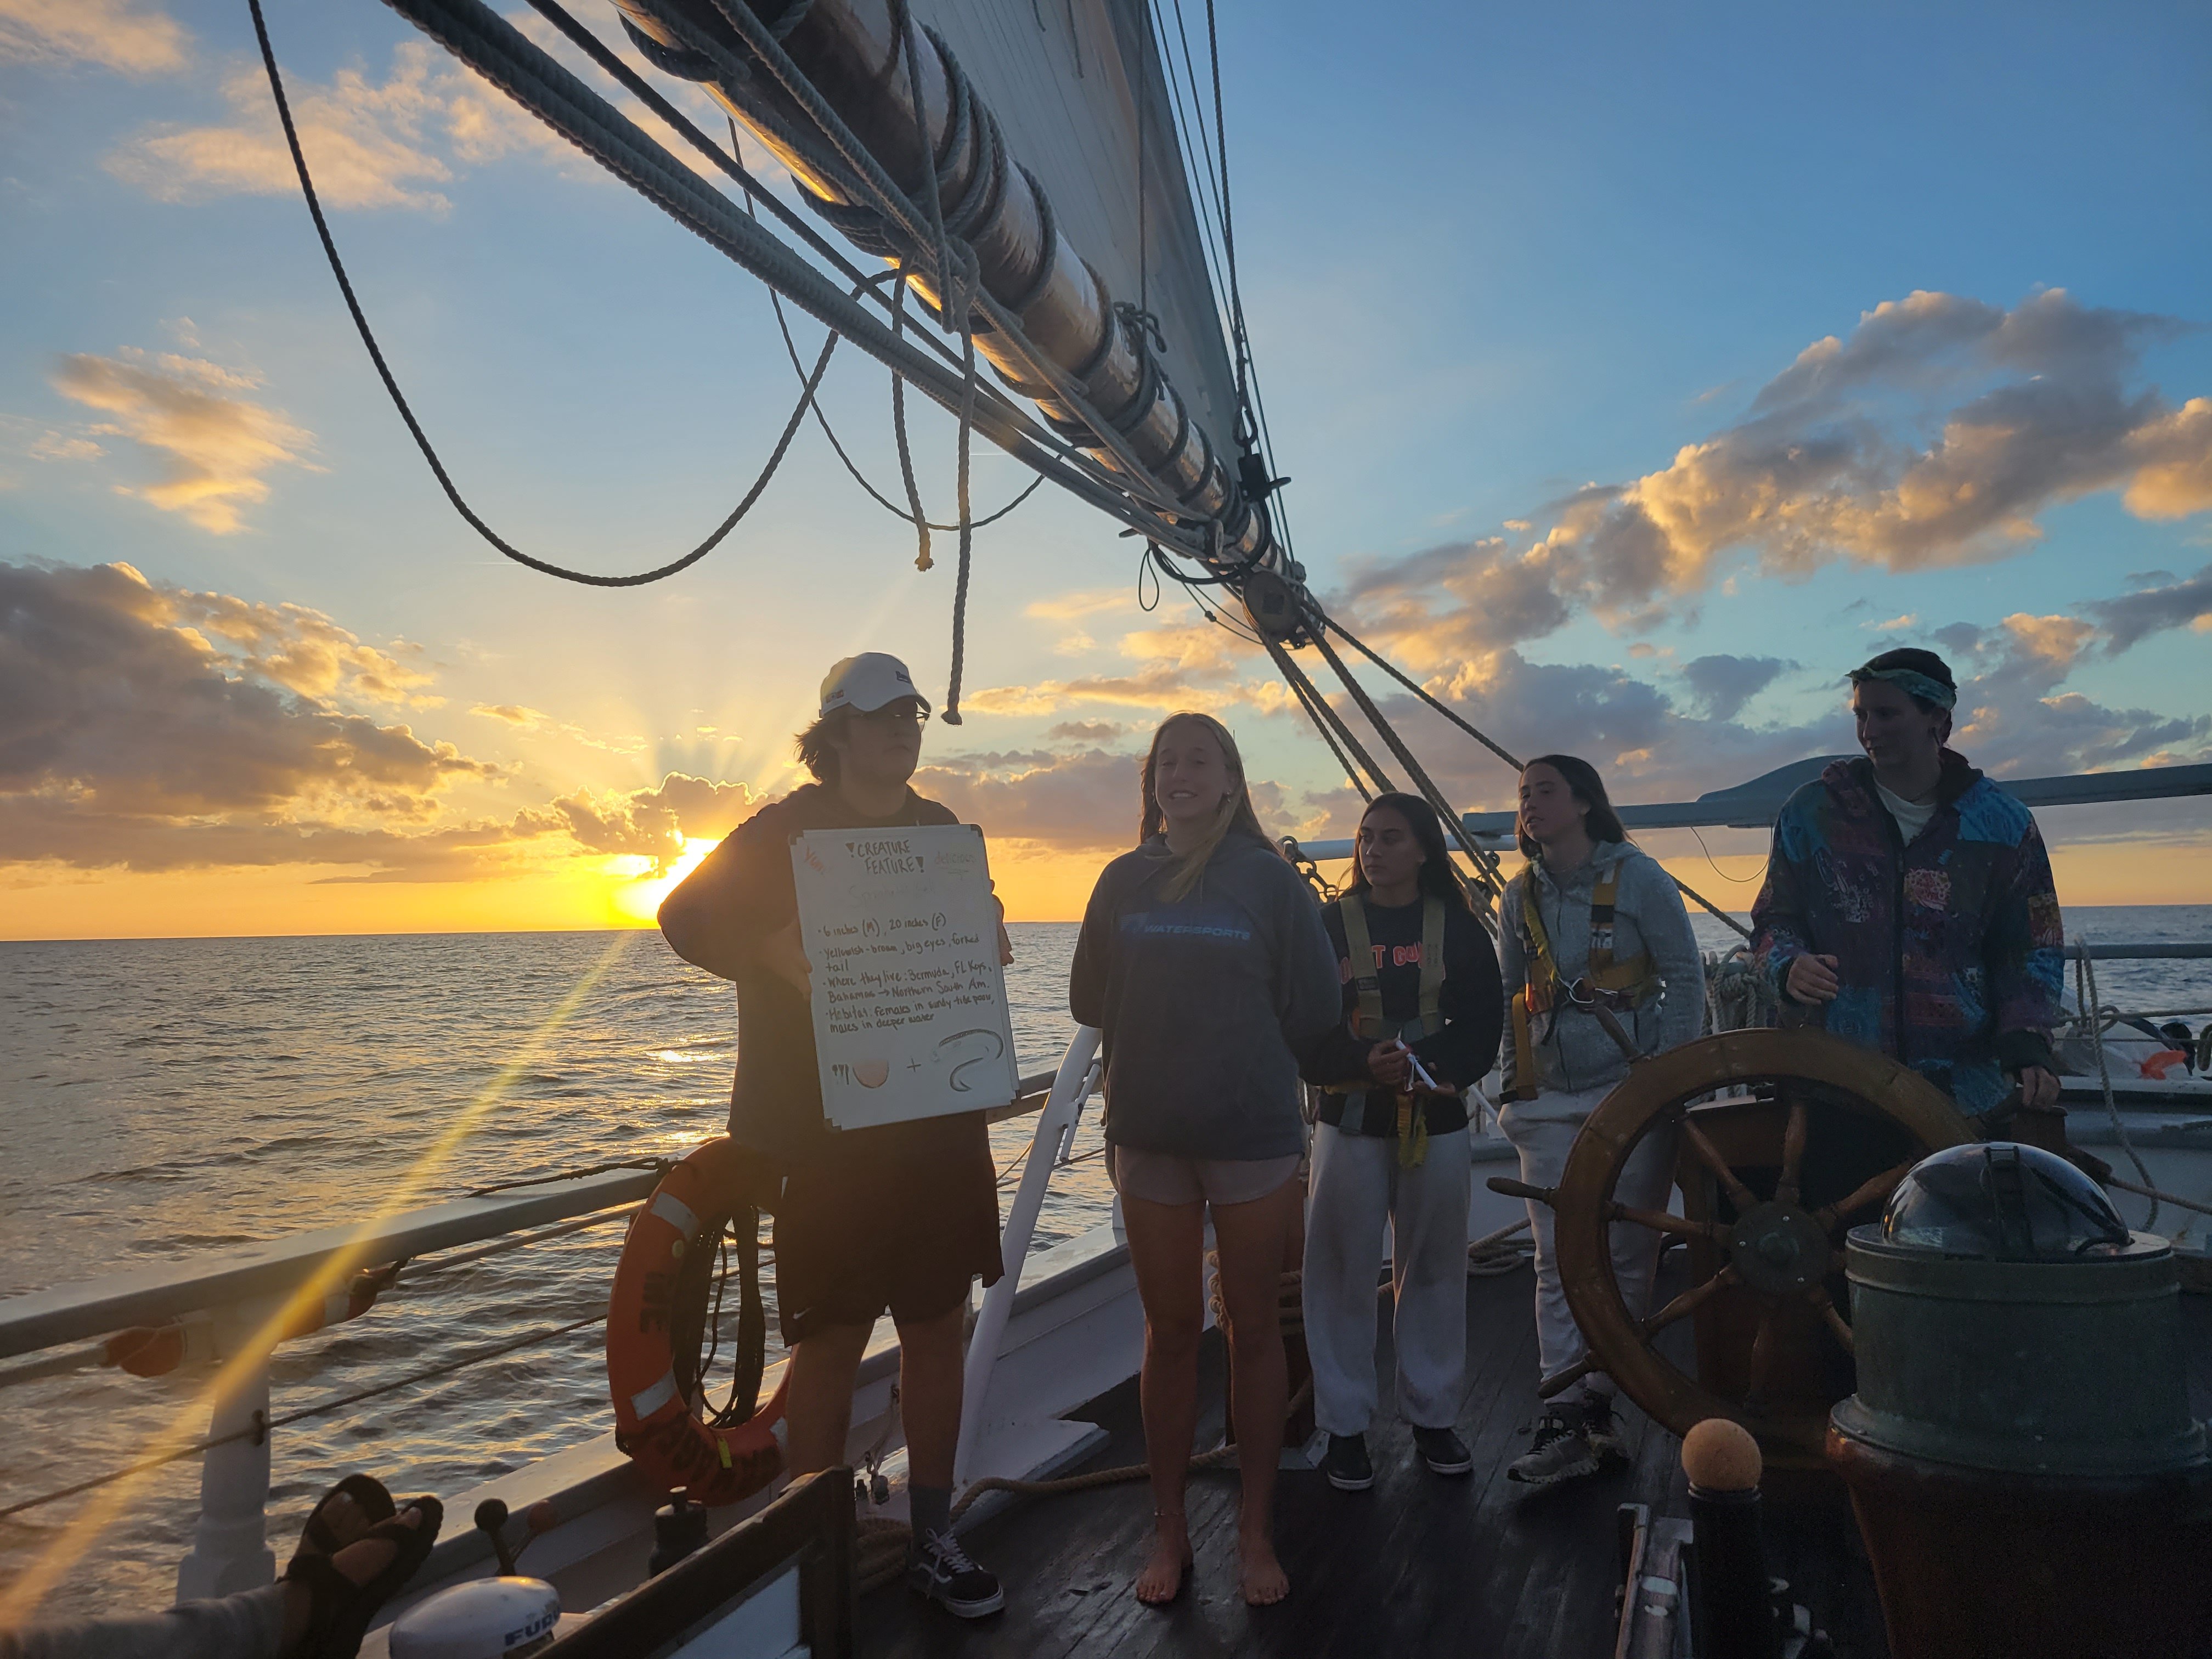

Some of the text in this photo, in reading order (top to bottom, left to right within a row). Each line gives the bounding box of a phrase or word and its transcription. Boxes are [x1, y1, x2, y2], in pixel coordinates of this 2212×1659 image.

[865, 856, 924, 874] FEATURE!
[823, 926, 831, 937] 6
[834, 924, 858, 935] inches
[889, 918, 901, 930] 20
[905, 918, 928, 928] inches
[933, 913, 946, 930] (F)
[1144, 924, 1251, 941] WATERSPORTS
[905, 941, 923, 954] big
[826, 958, 848, 972] tail
[860, 972, 882, 988] they
[955, 960, 966, 974] FL
[827, 978, 990, 1003] Bahamas Northern South Am.
[913, 1001, 924, 1011] in
[830, 1023, 858, 1034] males
[862, 1020, 873, 1029] in
[876, 1018, 905, 1030] deeper
